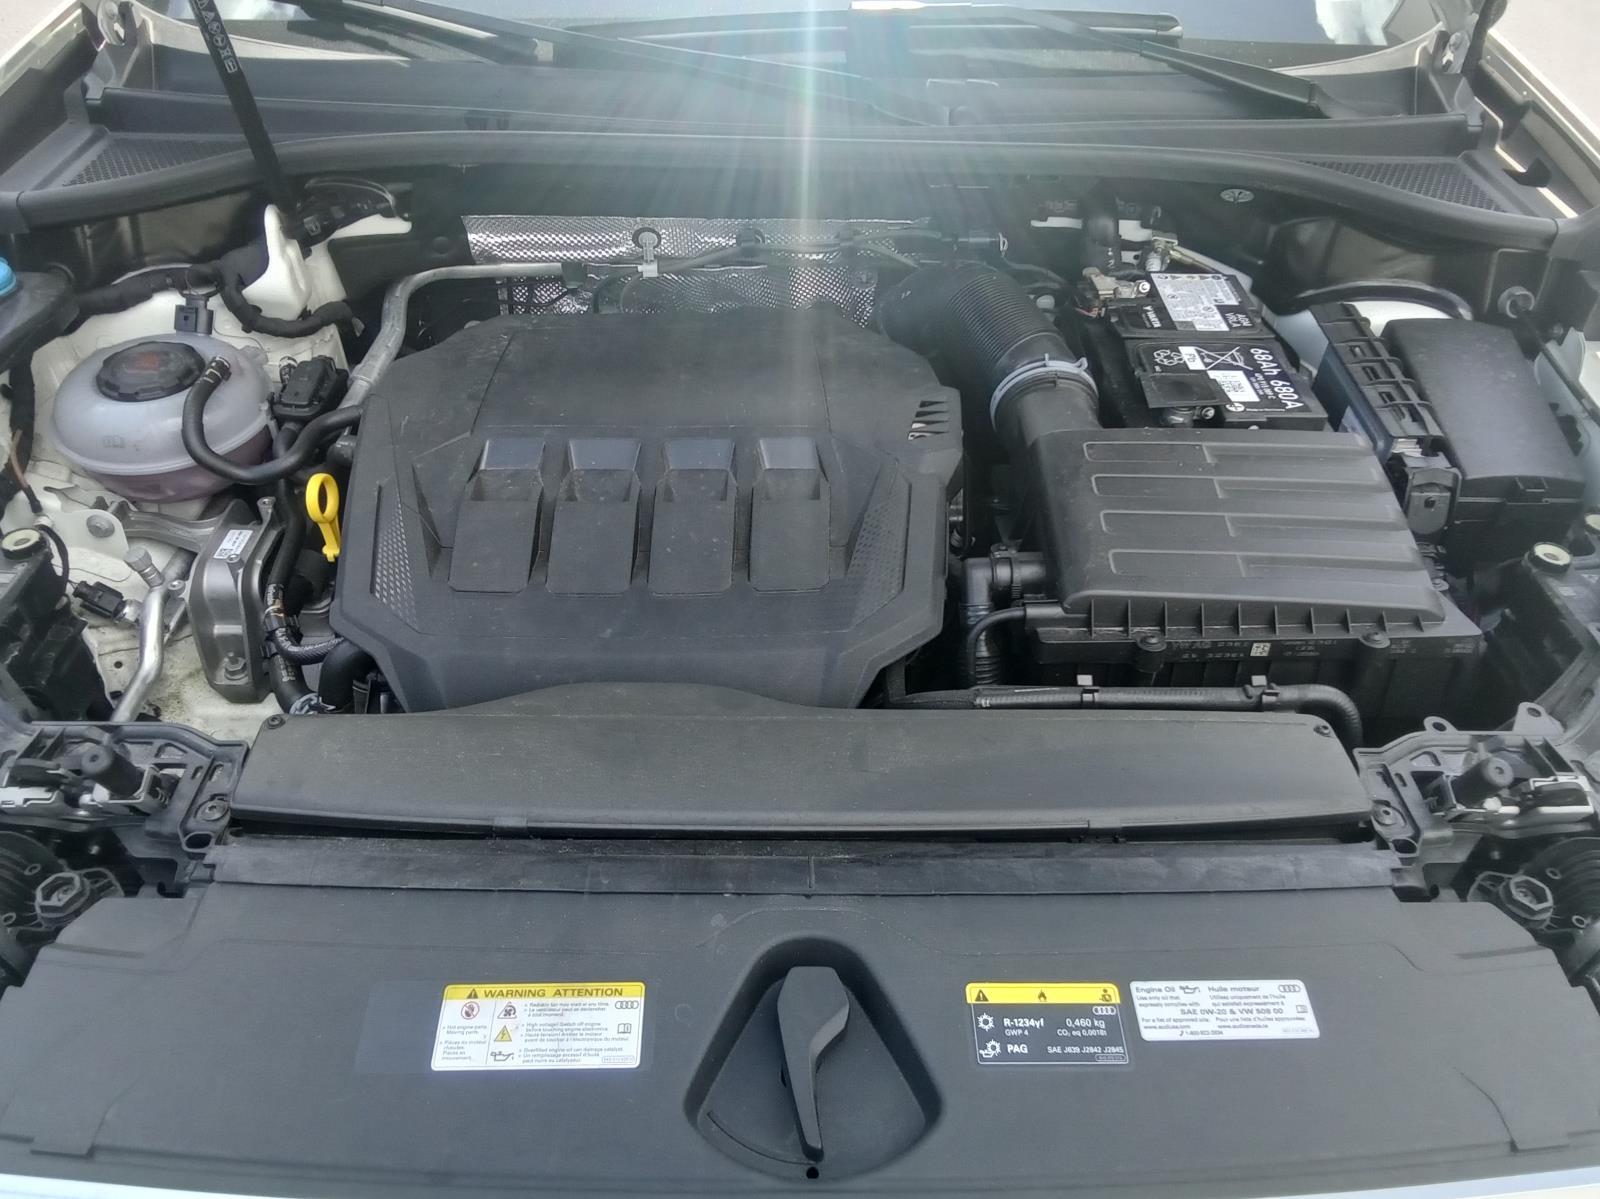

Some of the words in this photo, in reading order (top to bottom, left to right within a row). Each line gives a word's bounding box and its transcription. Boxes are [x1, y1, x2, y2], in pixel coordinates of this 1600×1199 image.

[1225, 312, 1241, 327] VRLA
[1236, 313, 1253, 326] AGM
[1250, 348, 1282, 375] 68Ah
[1270, 379, 1304, 409] 680A
[484, 988, 546, 998] WARNING
[552, 987, 623, 997] ATTENTION
[1003, 1018, 1044, 1029] R-1234yf
[1066, 1018, 1092, 1028] 0,460
[1094, 1018, 1106, 1028] kg
[1007, 1044, 1028, 1054] PAG
